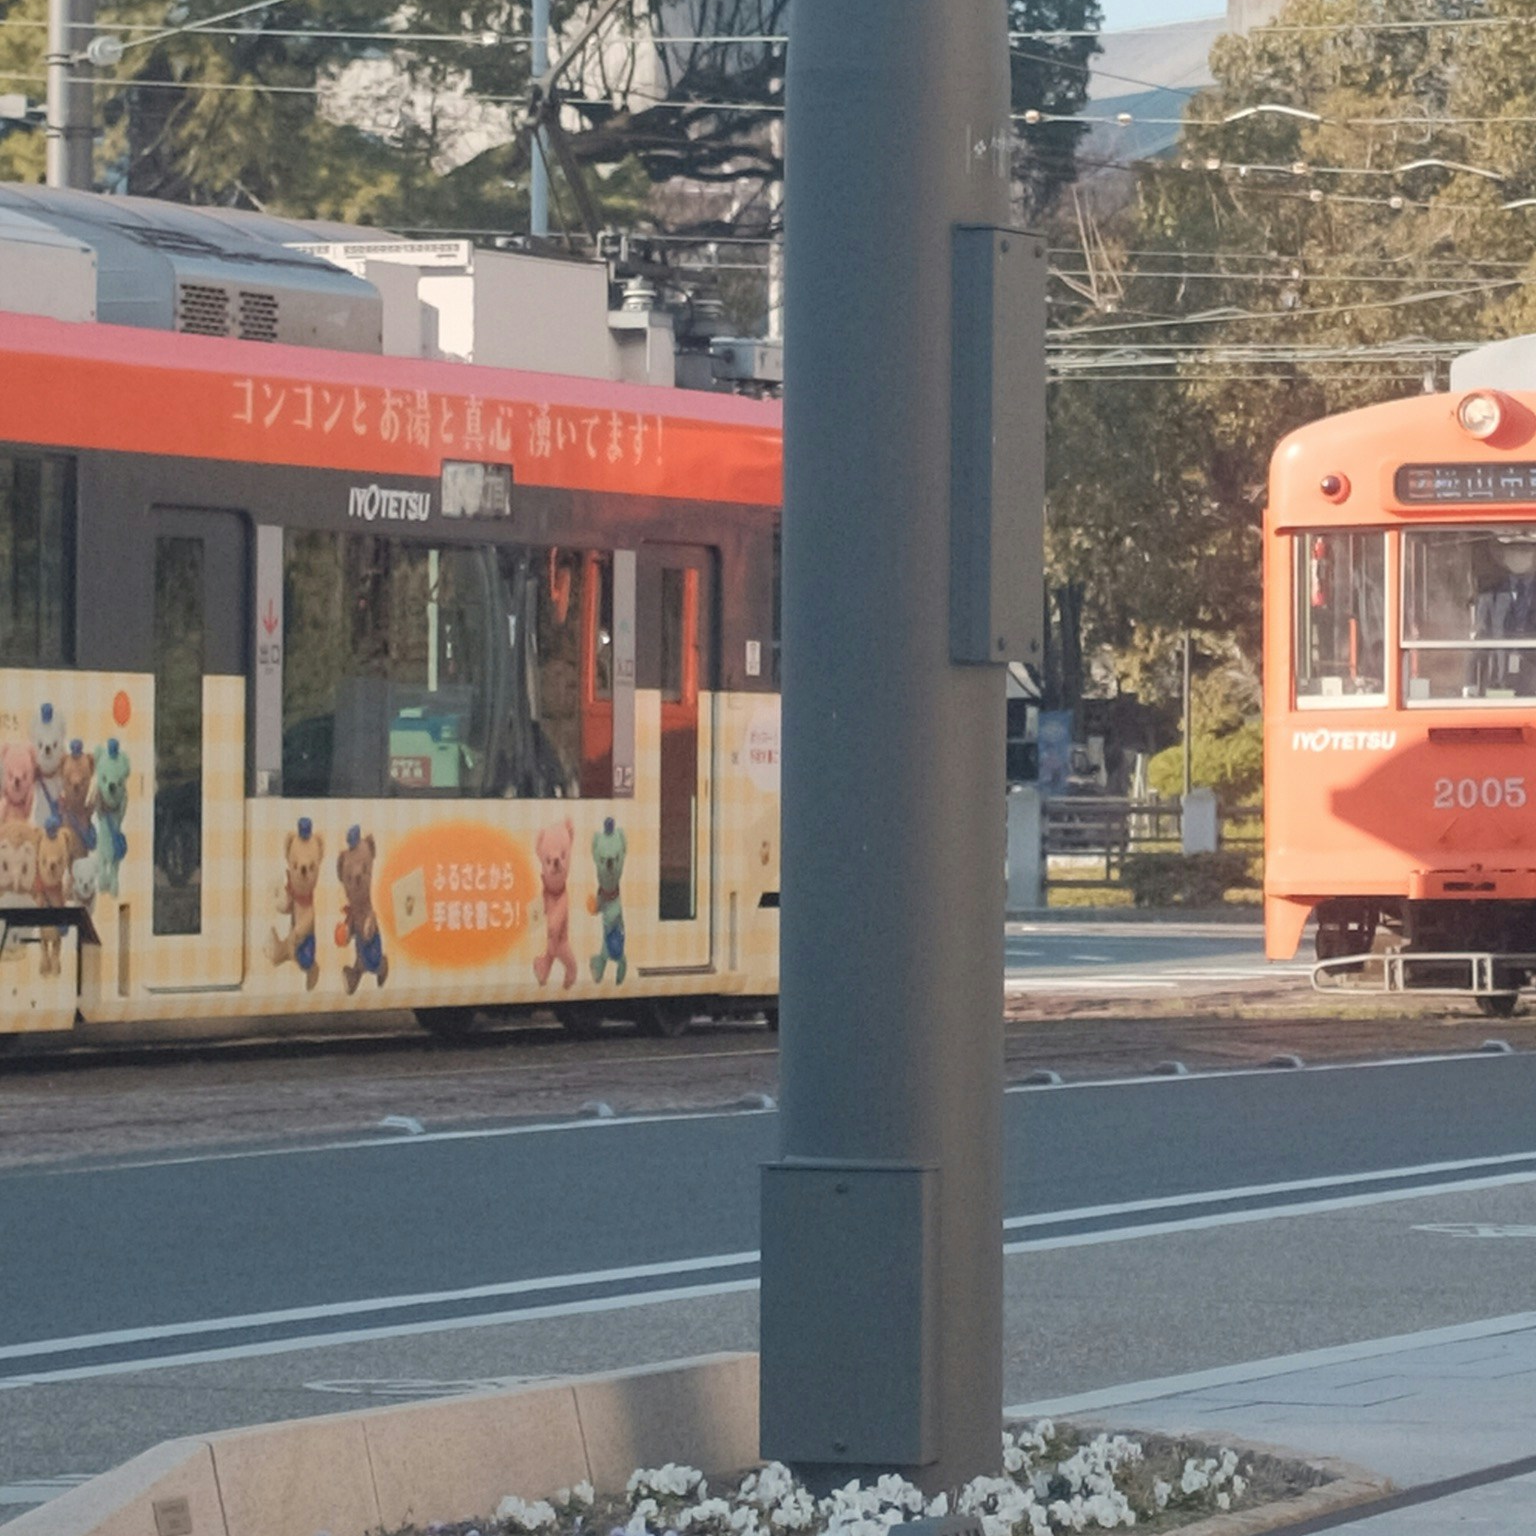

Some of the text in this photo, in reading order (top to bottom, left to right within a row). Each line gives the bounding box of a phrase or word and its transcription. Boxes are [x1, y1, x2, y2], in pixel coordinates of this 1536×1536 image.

[349, 484, 430, 521] IYOTETSU
[1293, 728, 1397, 752] IYOTETSU
[1434, 777, 1527, 808] 2005
